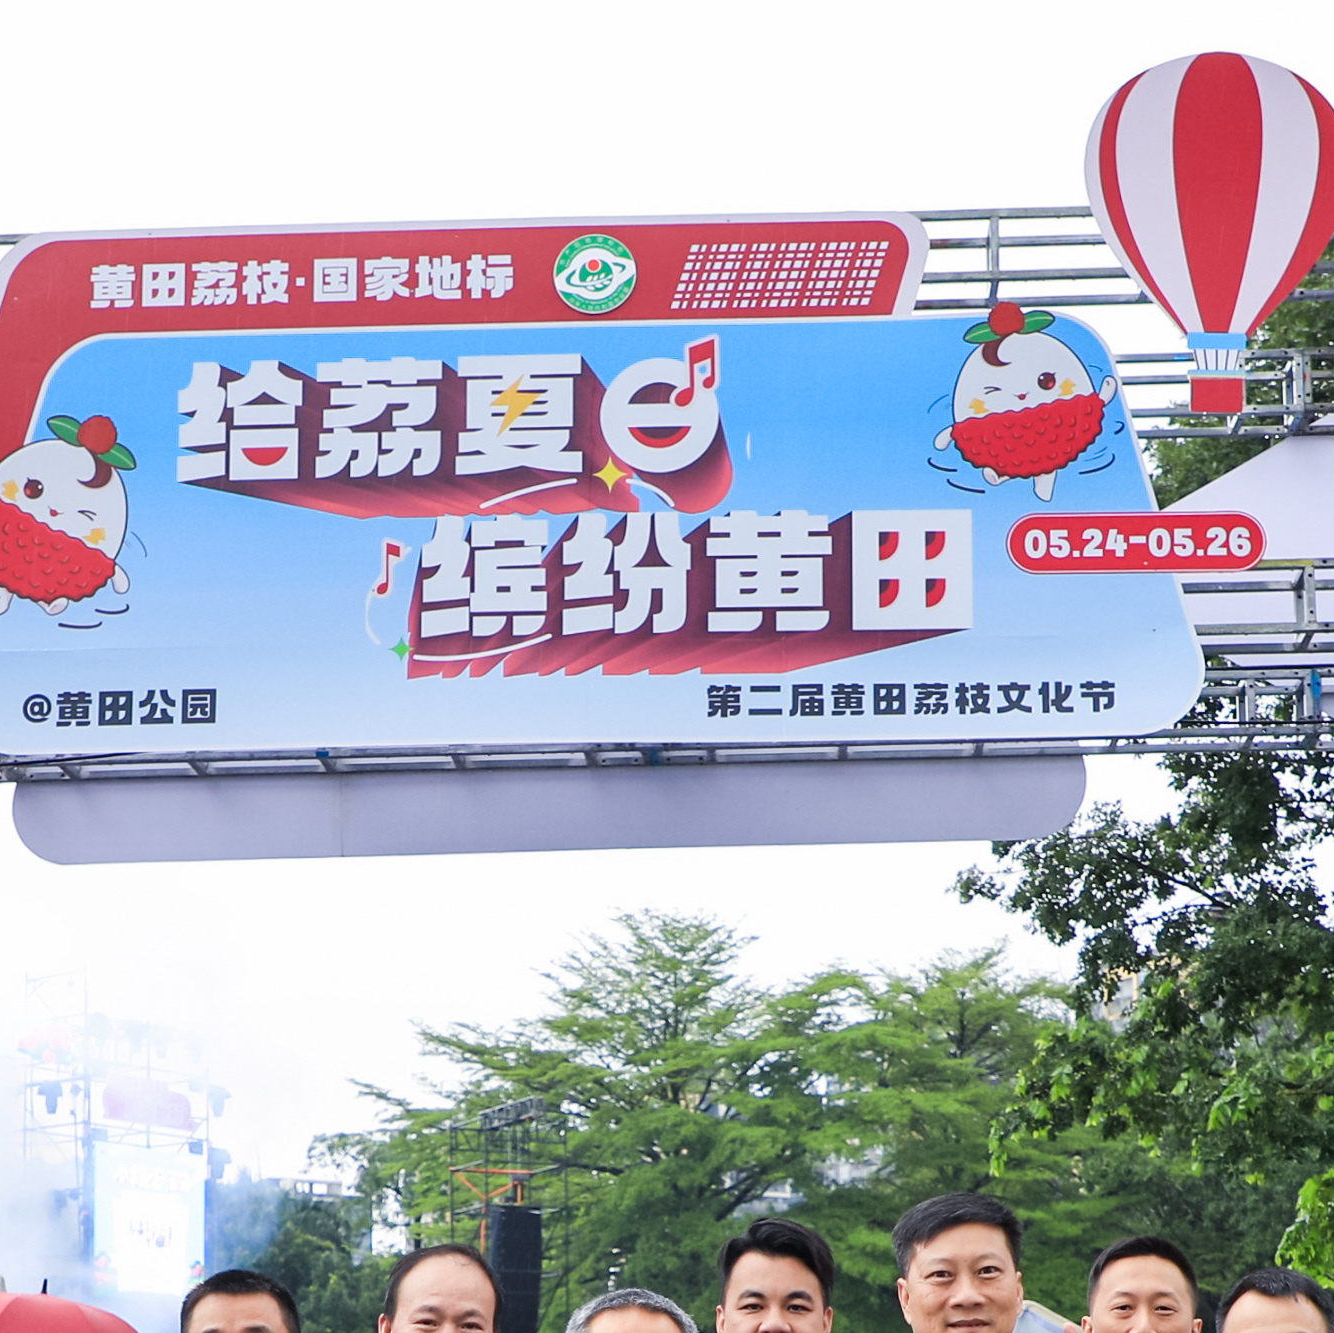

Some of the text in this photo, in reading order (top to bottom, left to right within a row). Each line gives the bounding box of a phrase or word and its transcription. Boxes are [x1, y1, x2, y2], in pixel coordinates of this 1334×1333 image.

[89, 253, 515, 309] 黄田荔枝·国家地标
[1024, 526, 1254, 561] 05.24-05.26
[419, 507, 974, 640] 缤纷黄田
[22, 688, 218, 729] @黄田公园
[705, 680, 1117, 719] 第二届黄田荔枝文化节
